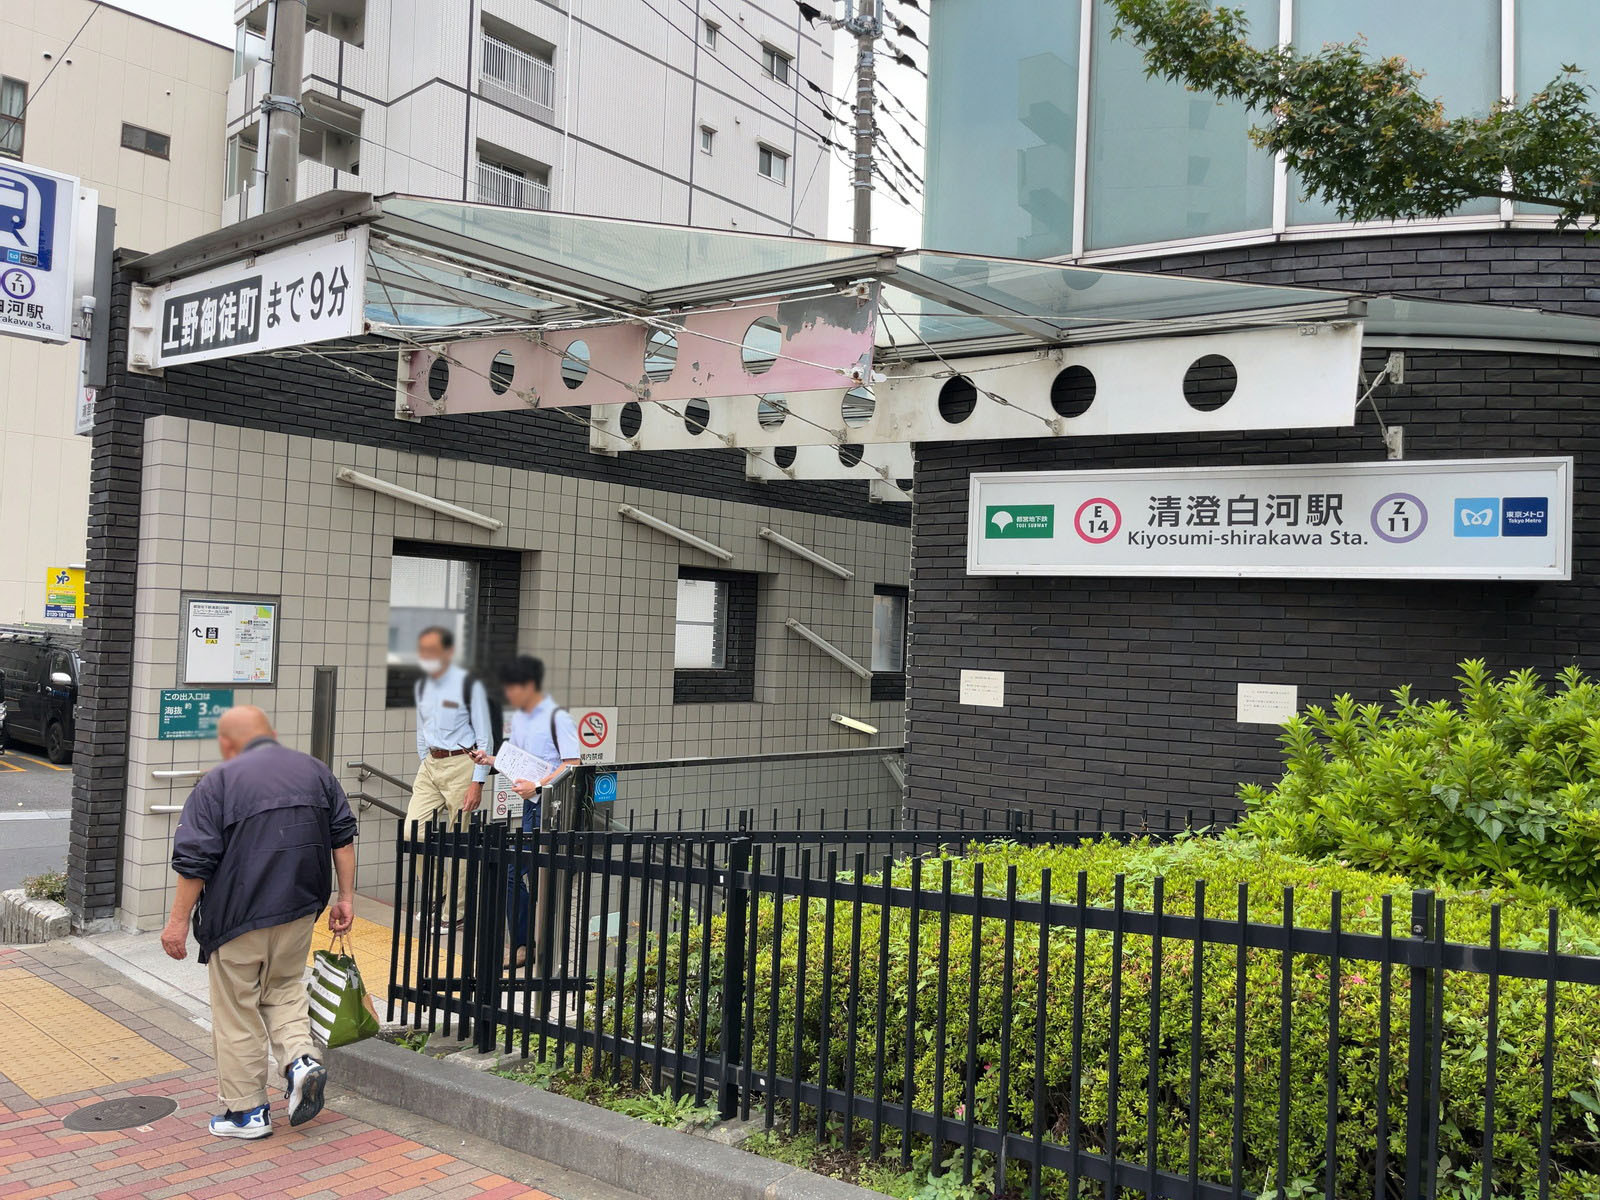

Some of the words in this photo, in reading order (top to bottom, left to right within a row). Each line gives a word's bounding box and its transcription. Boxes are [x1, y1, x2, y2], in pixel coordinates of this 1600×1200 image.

[15, 273, 23, 283] Z
[12, 282, 25, 293] 11
[163, 287, 259, 350] 上野御徒町
[267, 265, 349, 328] まで9分
[36, 321, 54, 331] Sta.
[1094, 505, 1102, 518] E
[1147, 493, 1344, 528] 清澄白河駅
[1393, 501, 1406, 515] Z
[1016, 515, 1048, 523] 都営地下鉄
[1387, 517, 1409, 532] 11
[1088, 520, 1109, 533] 14
[1127, 530, 1322, 549] Kiyosumi-shirakawa
[1329, 530, 1369, 546] Sta.
[164, 693, 210, 701] この出入口は
[164, 706, 183, 715] 海抜
